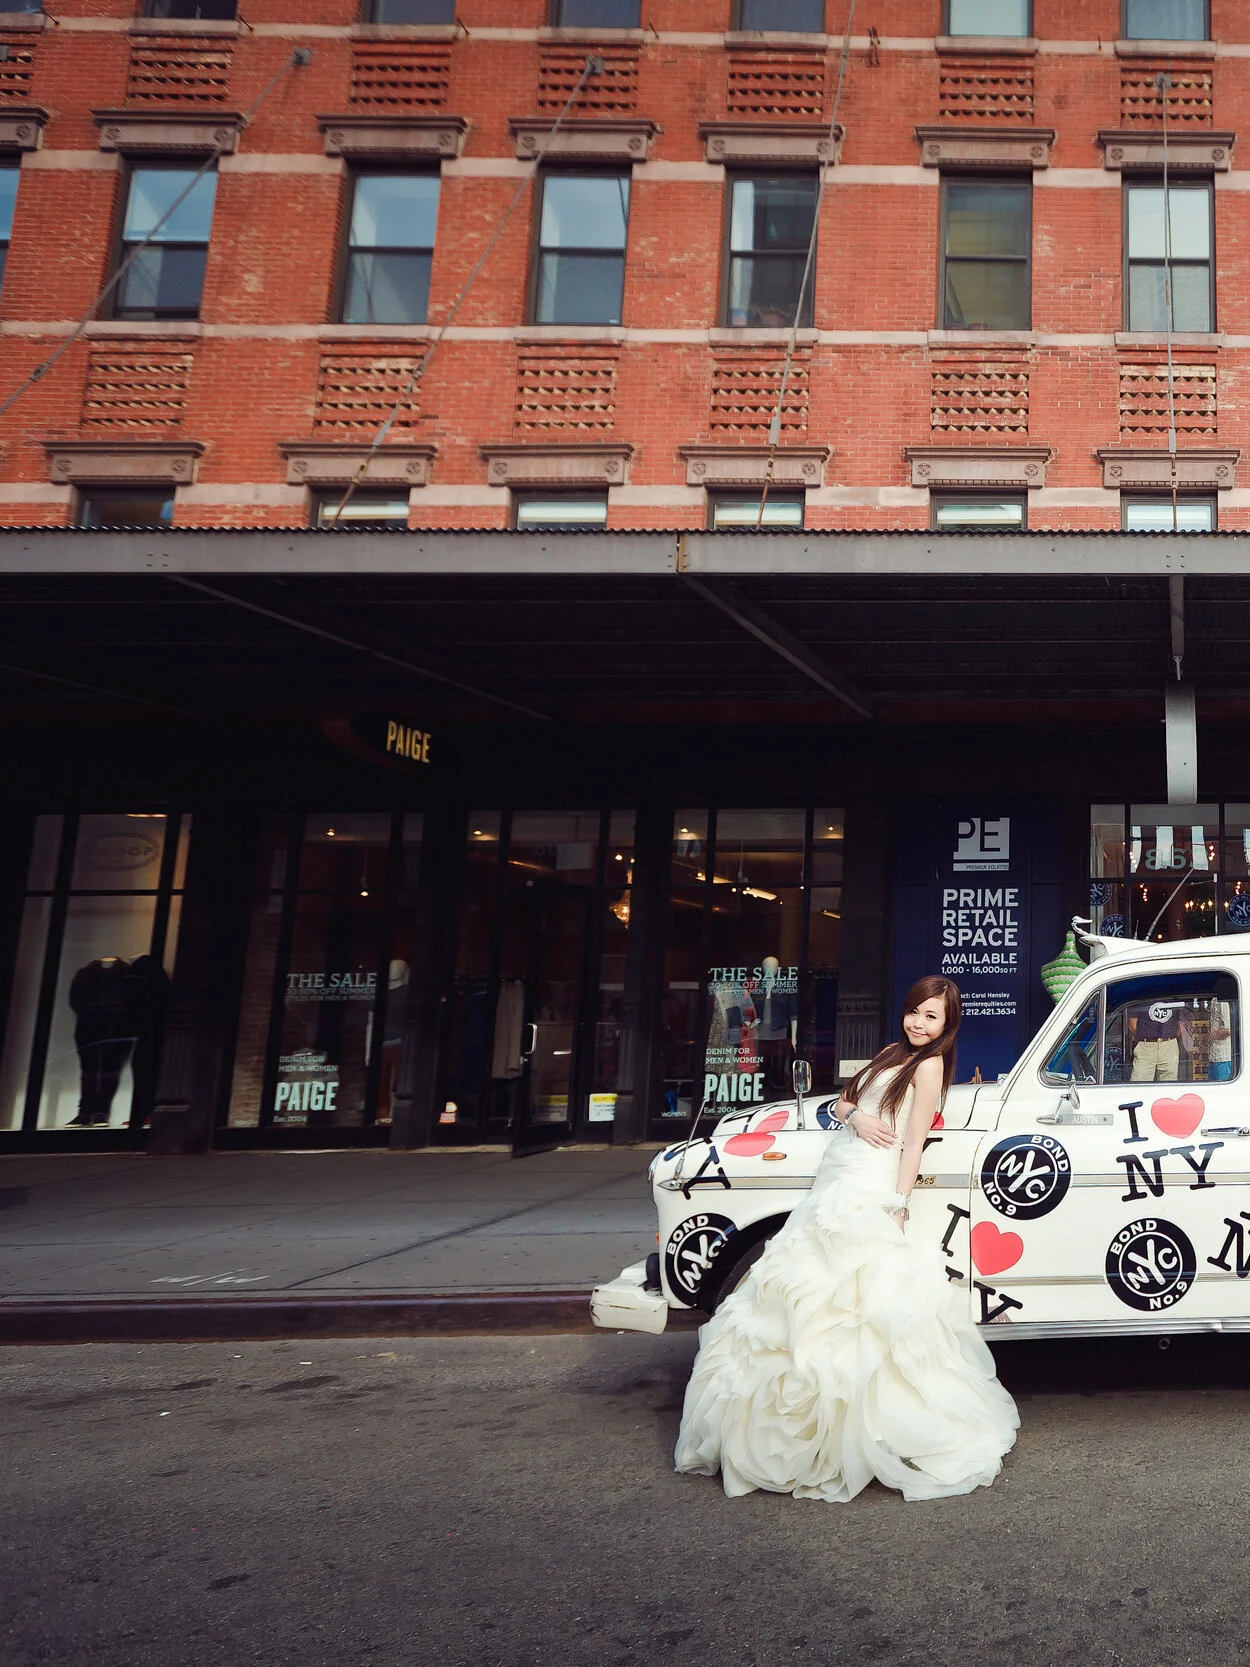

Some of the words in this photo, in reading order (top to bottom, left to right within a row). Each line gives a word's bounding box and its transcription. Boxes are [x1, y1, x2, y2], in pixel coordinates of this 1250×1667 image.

[386, 720, 432, 763] PAIGE
[943, 888, 1019, 907] PRIME
[942, 909, 1018, 926] RETAIL
[1107, 922, 1123, 937] NYC
[942, 928, 1018, 947] SPACE
[941, 952, 1018, 965] AVAILABLE
[941, 966, 964, 974] 1,000
[286, 973, 325, 988] THE
[329, 972, 378, 988] SALE
[710, 968, 748, 982] THE
[752, 967, 798, 981] SALE
[319, 988, 336, 996] OFF
[338, 987, 376, 995] SUMMER
[966, 1008, 1017, 1016] 212.421.3634
[274, 1081, 340, 1112] PAIGE
[704, 1073, 765, 1102] PAIGE
[1118, 1100, 1150, 1144] I
[1031, 1134, 1069, 1172] BOND
[999, 1149, 1051, 1199] NYC
[1116, 1141, 1225, 1203] NY
[666, 1215, 710, 1256] BOND
[940, 1203, 971, 1258] I
[1110, 1219, 1159, 1255] BOND
[682, 1233, 730, 1289] NYC
[1126, 1238, 1179, 1291] NYC
